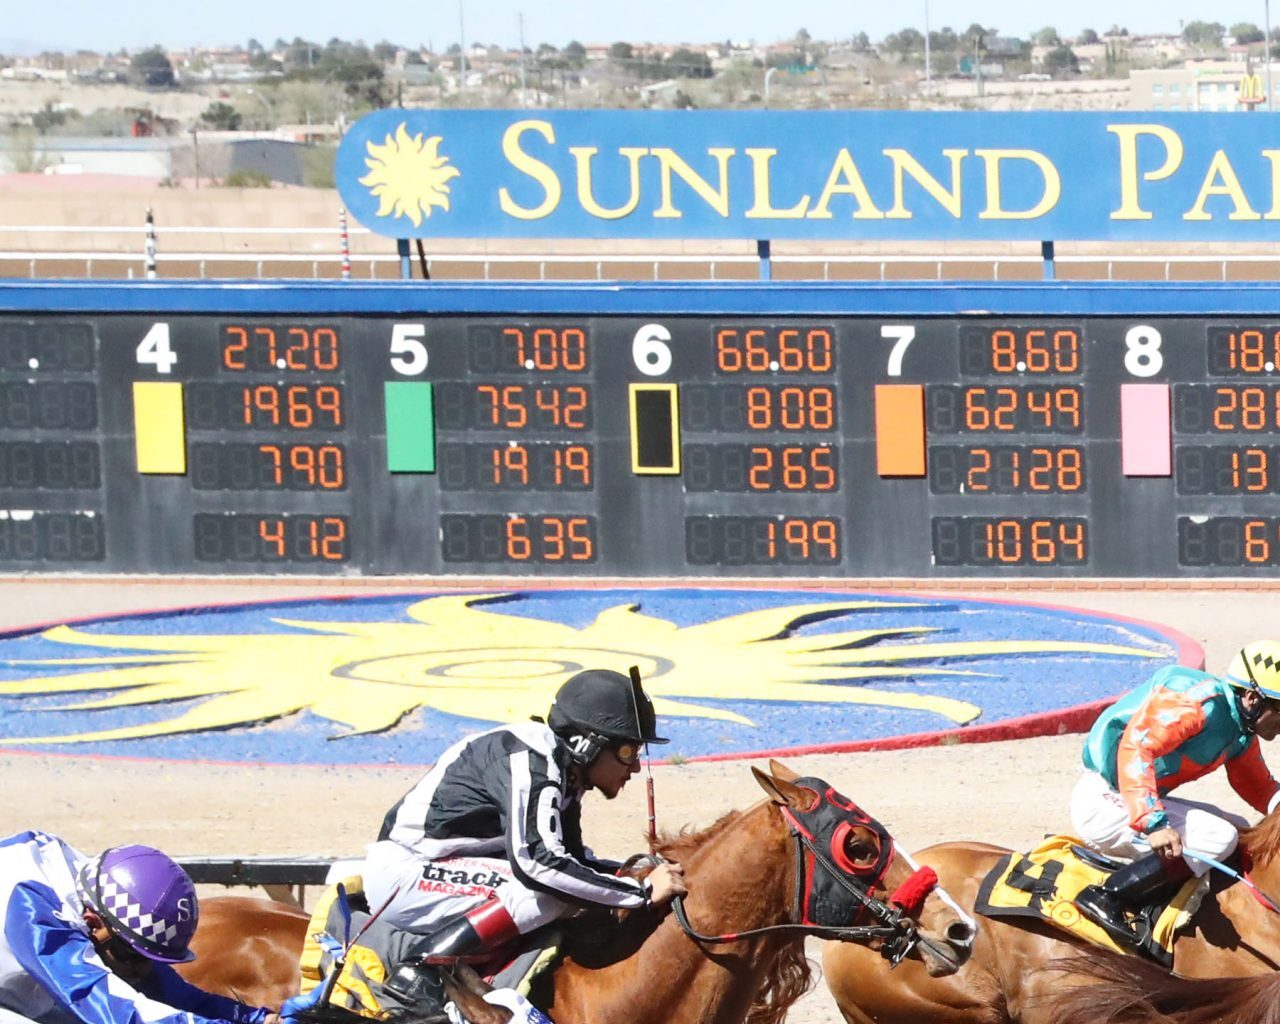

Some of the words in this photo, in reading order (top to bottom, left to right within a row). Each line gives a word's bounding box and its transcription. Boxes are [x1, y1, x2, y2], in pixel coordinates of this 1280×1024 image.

[502, 120, 1060, 219] SUNLAND
[137, 323, 177, 372] 4
[225, 328, 337, 369] 27.20
[391, 324, 427, 374] 5
[504, 329, 585, 370] 7.00
[632, 324, 671, 375] 6
[718, 331, 831, 371] 66.60
[881, 326, 915, 375] 7
[993, 331, 1077, 371] 8.60
[1125, 325, 1163, 376] 8
[244, 387, 340, 427] 1969
[478, 386, 586, 427] 7542
[748, 388, 832, 428] 808
[966, 389, 1078, 429] 6249
[261, 446, 342, 487] 790
[494, 447, 588, 485] 1919
[750, 448, 834, 489] 265
[969, 449, 1080, 489] 2128
[261, 519, 344, 558] 412
[507, 519, 591, 559] 635
[768, 521, 836, 557] 199
[987, 522, 1083, 561] 1064
[418, 880, 498, 901] MAGAZINE
[422, 861, 509, 889] track
